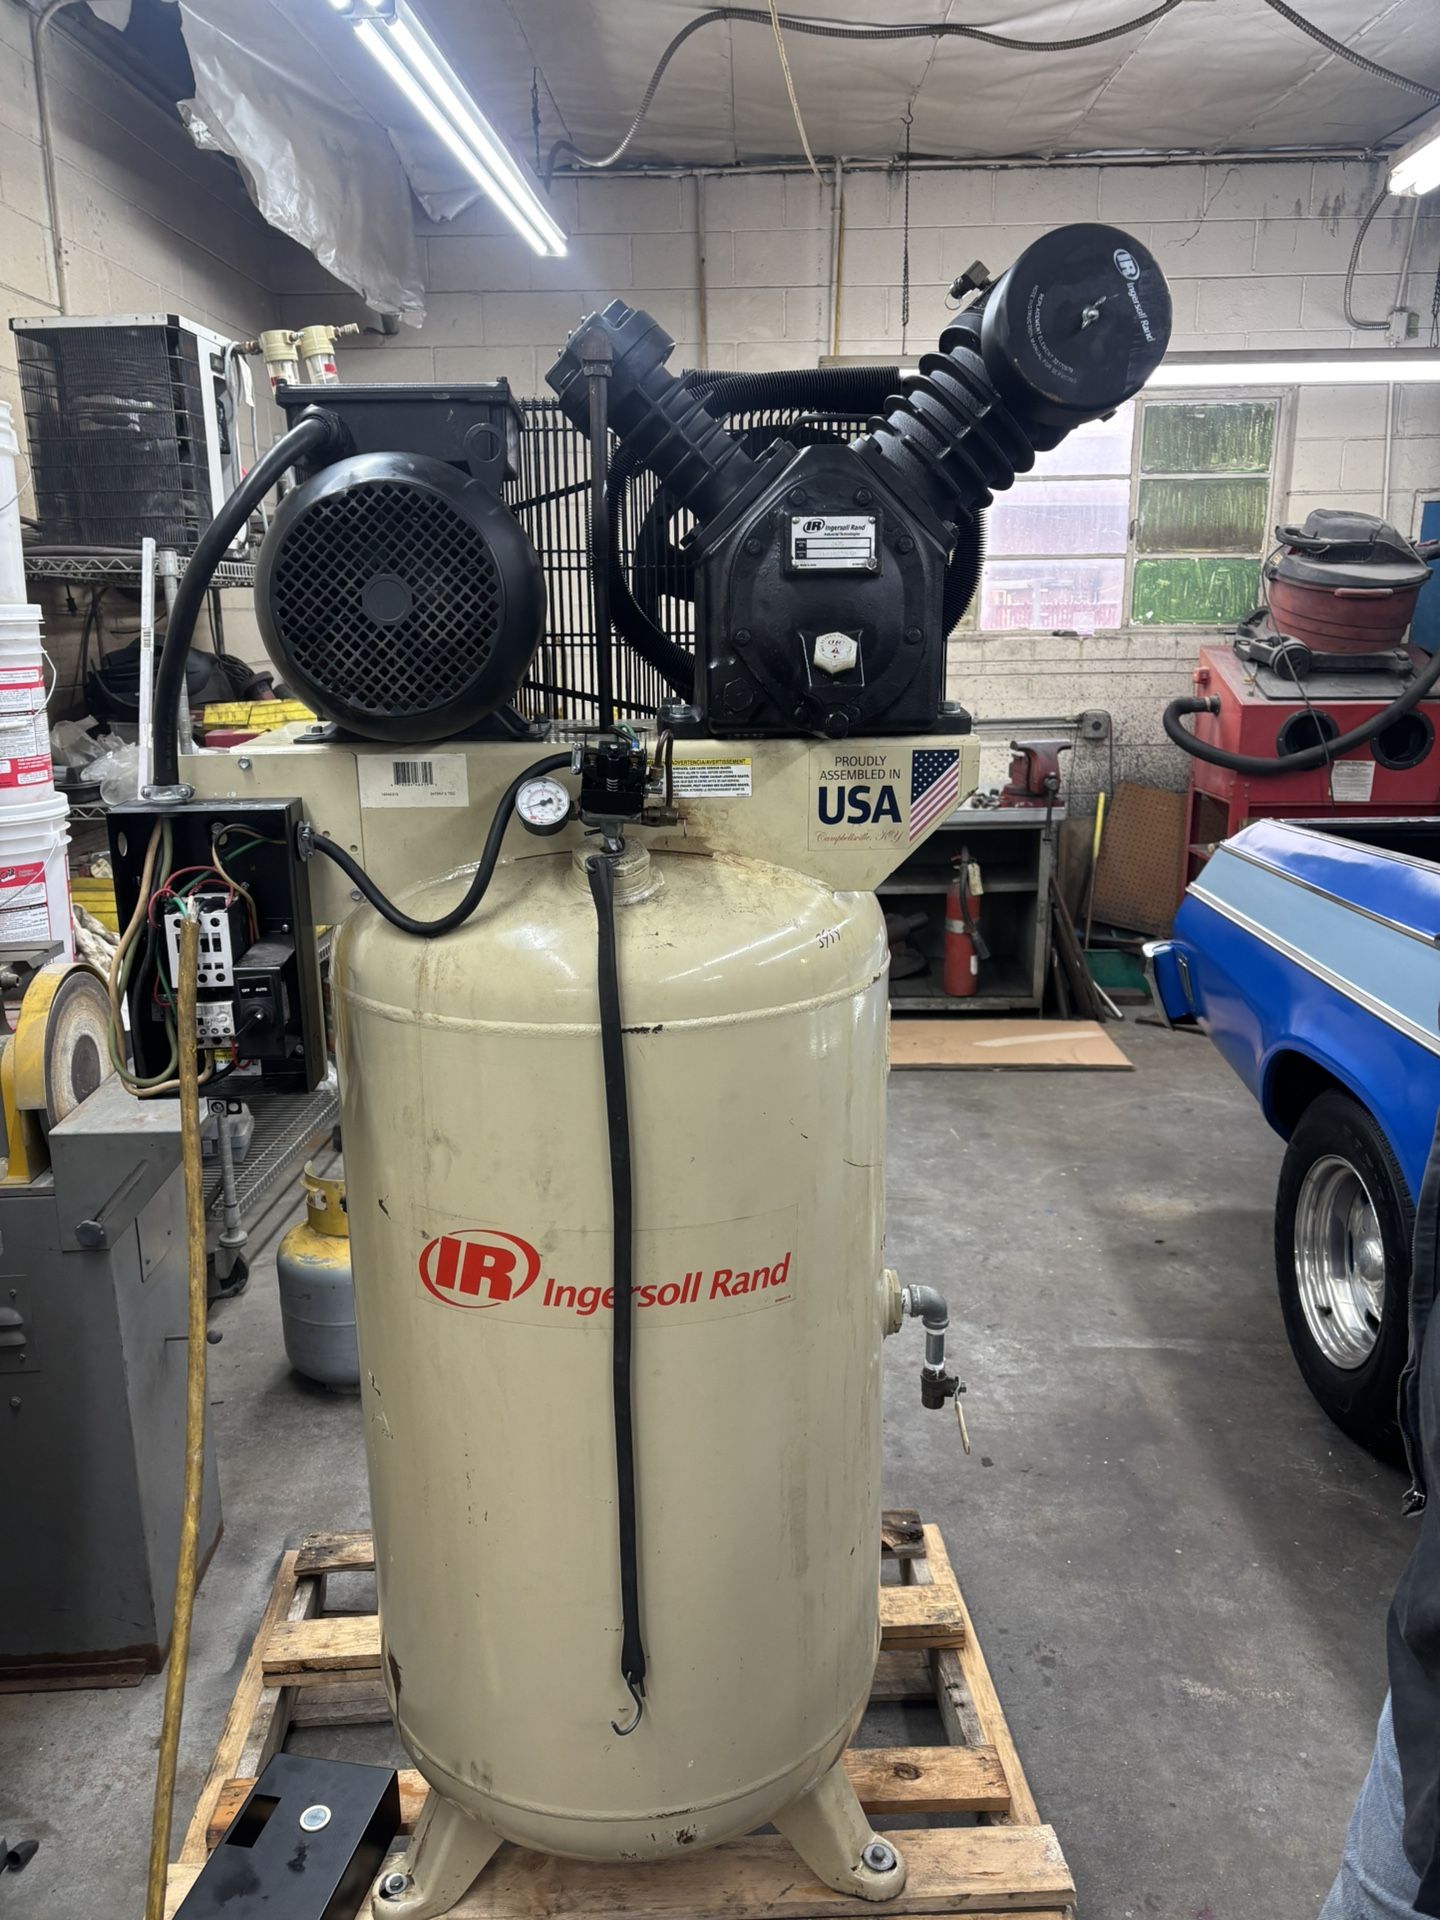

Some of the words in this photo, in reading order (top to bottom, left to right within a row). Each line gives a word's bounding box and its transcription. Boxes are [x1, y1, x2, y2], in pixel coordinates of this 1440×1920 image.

[1116, 252, 1137, 279] IR
[1126, 282, 1148, 322] Ingersoll
[1140, 319, 1156, 342] Rand
[824, 524, 850, 532] Ingersoll
[820, 770, 886, 780] ASSEMBLED
[889, 768, 901, 779] IN
[834, 756, 887, 766] PROUDLY
[818, 785, 902, 826] USA
[876, 830, 905, 843] KY
[432, 1232, 522, 1304] IR
[709, 1251, 792, 1300] Rand
